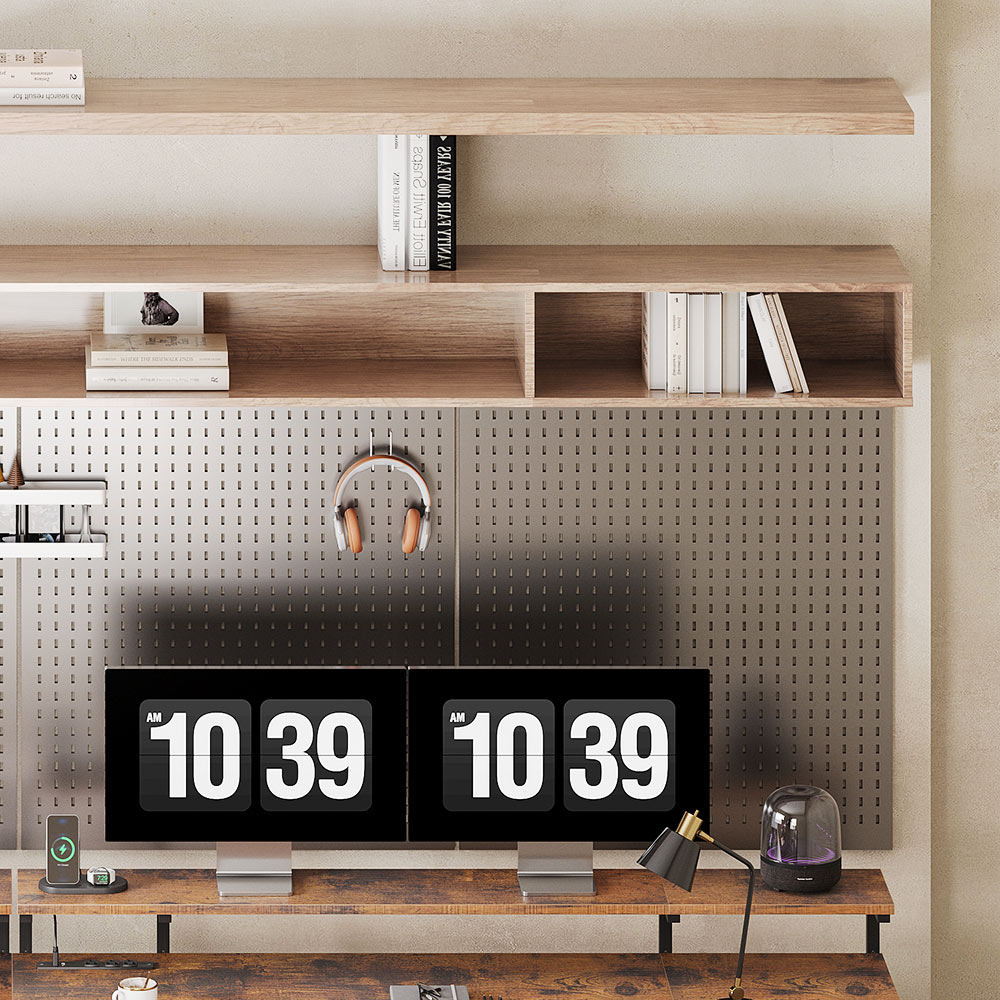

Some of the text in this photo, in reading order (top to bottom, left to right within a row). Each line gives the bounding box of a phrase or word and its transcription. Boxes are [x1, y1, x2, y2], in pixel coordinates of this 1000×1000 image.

[12, 92, 82, 101] No search result for
[146, 712, 162, 723] AM
[449, 712, 466, 723] AM
[150, 711, 366, 800] 10 39
[453, 711, 669, 800] 10 39
